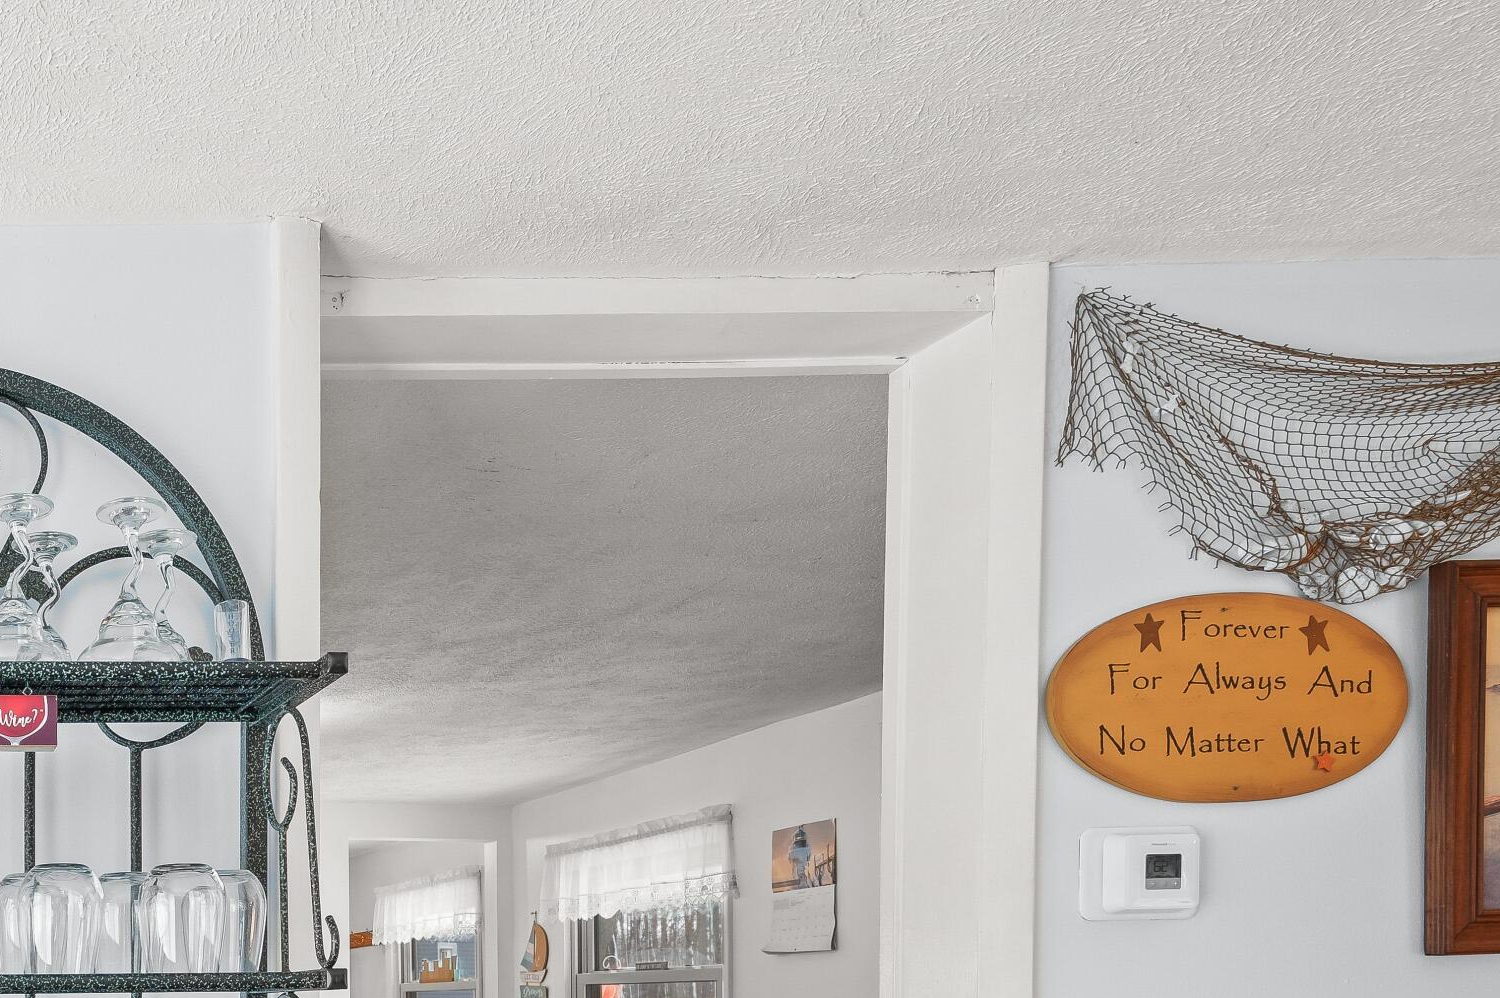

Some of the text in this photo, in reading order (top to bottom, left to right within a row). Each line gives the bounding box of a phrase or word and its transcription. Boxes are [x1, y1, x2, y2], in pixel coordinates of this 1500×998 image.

[1180, 610, 1290, 642] Forever
[1107, 661, 1374, 701] For Always And
[1098, 724, 1361, 759] No Matter What
